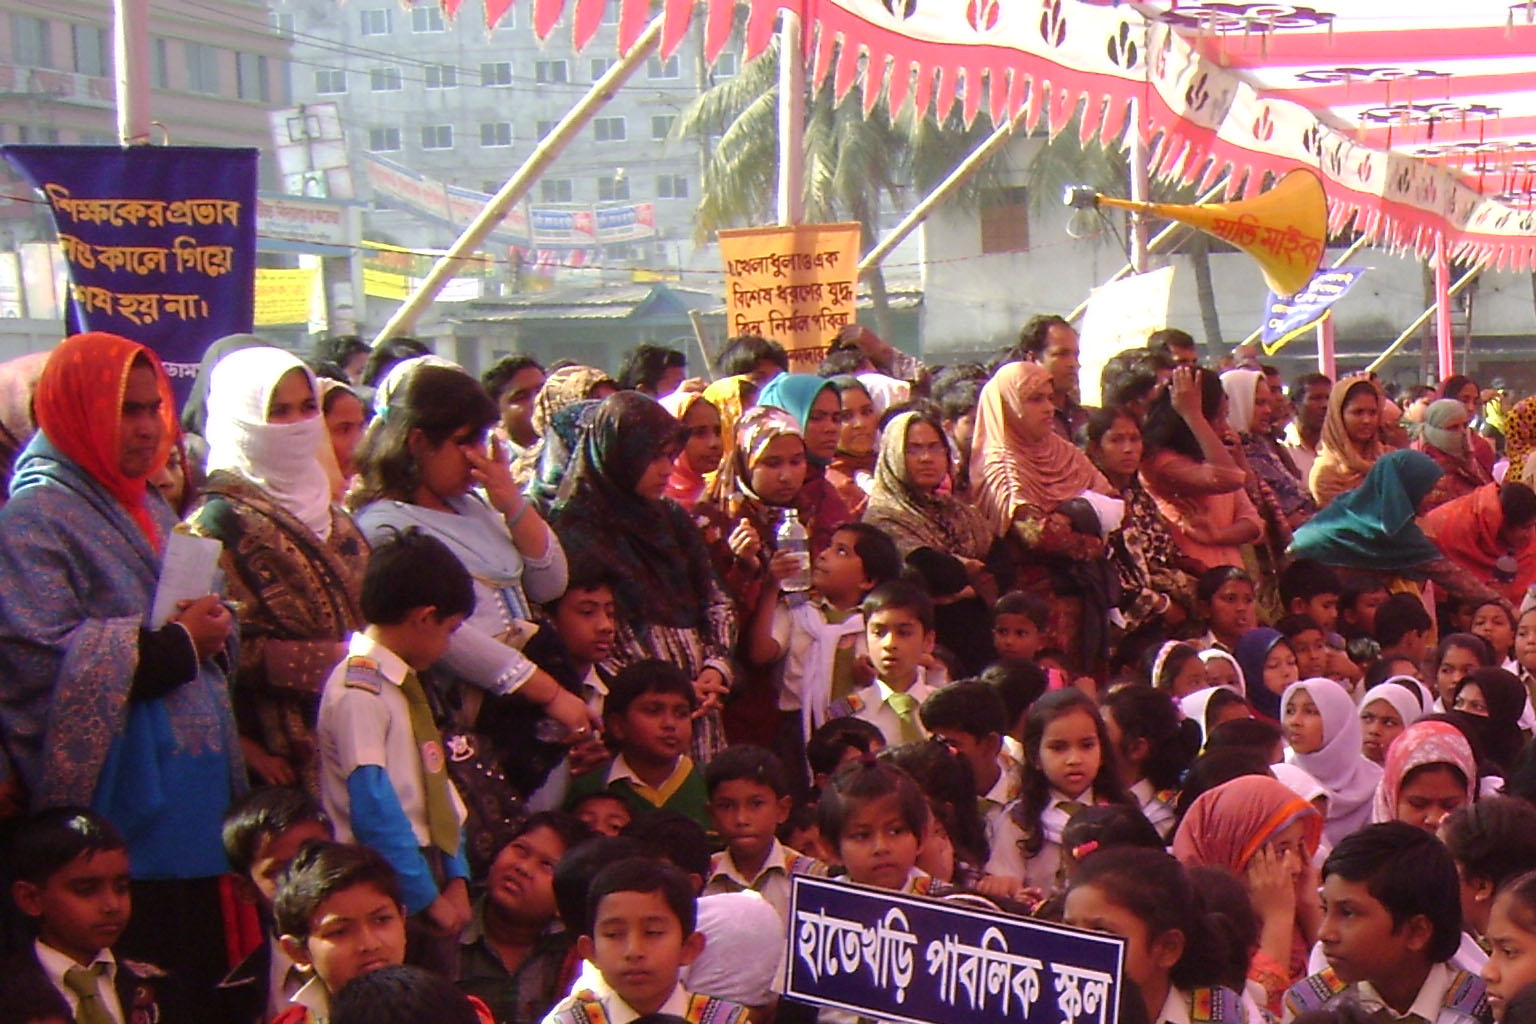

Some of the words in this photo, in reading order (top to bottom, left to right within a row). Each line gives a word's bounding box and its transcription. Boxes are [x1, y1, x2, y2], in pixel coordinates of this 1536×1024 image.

[167, 199, 241, 227] প্রভাব
[172, 235, 233, 277] গিয়ে
[114, 293, 159, 325] হয়
[732, 282, 774, 309] বিশেষ
[797, 906, 919, 1004] হাতেখড়ি
[926, 926, 1044, 1020] পাবলিক
